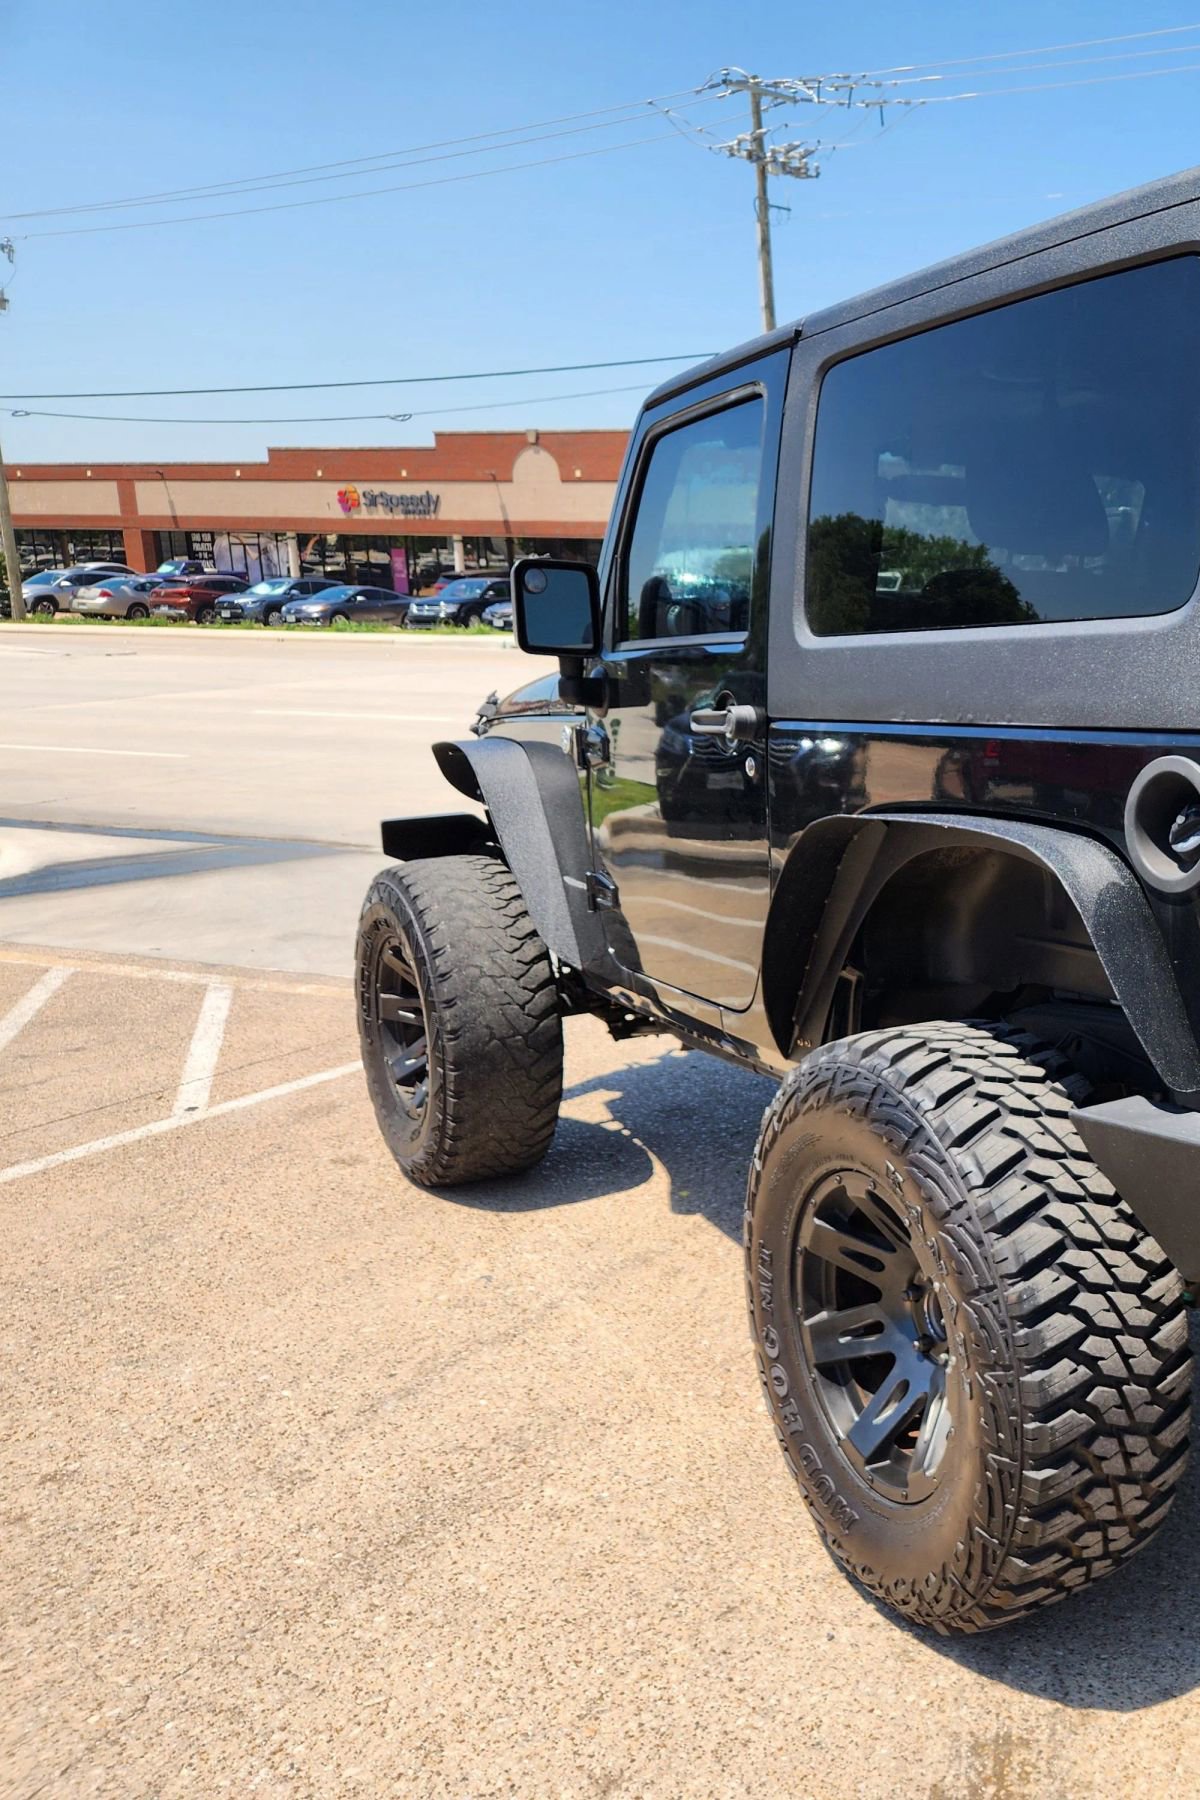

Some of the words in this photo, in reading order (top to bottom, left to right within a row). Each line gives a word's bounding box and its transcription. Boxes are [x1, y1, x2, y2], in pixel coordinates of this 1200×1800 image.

[757, 1239, 774, 1313] M/T
[763, 1324, 804, 1436] HOG
[800, 1442, 859, 1534] MUD
